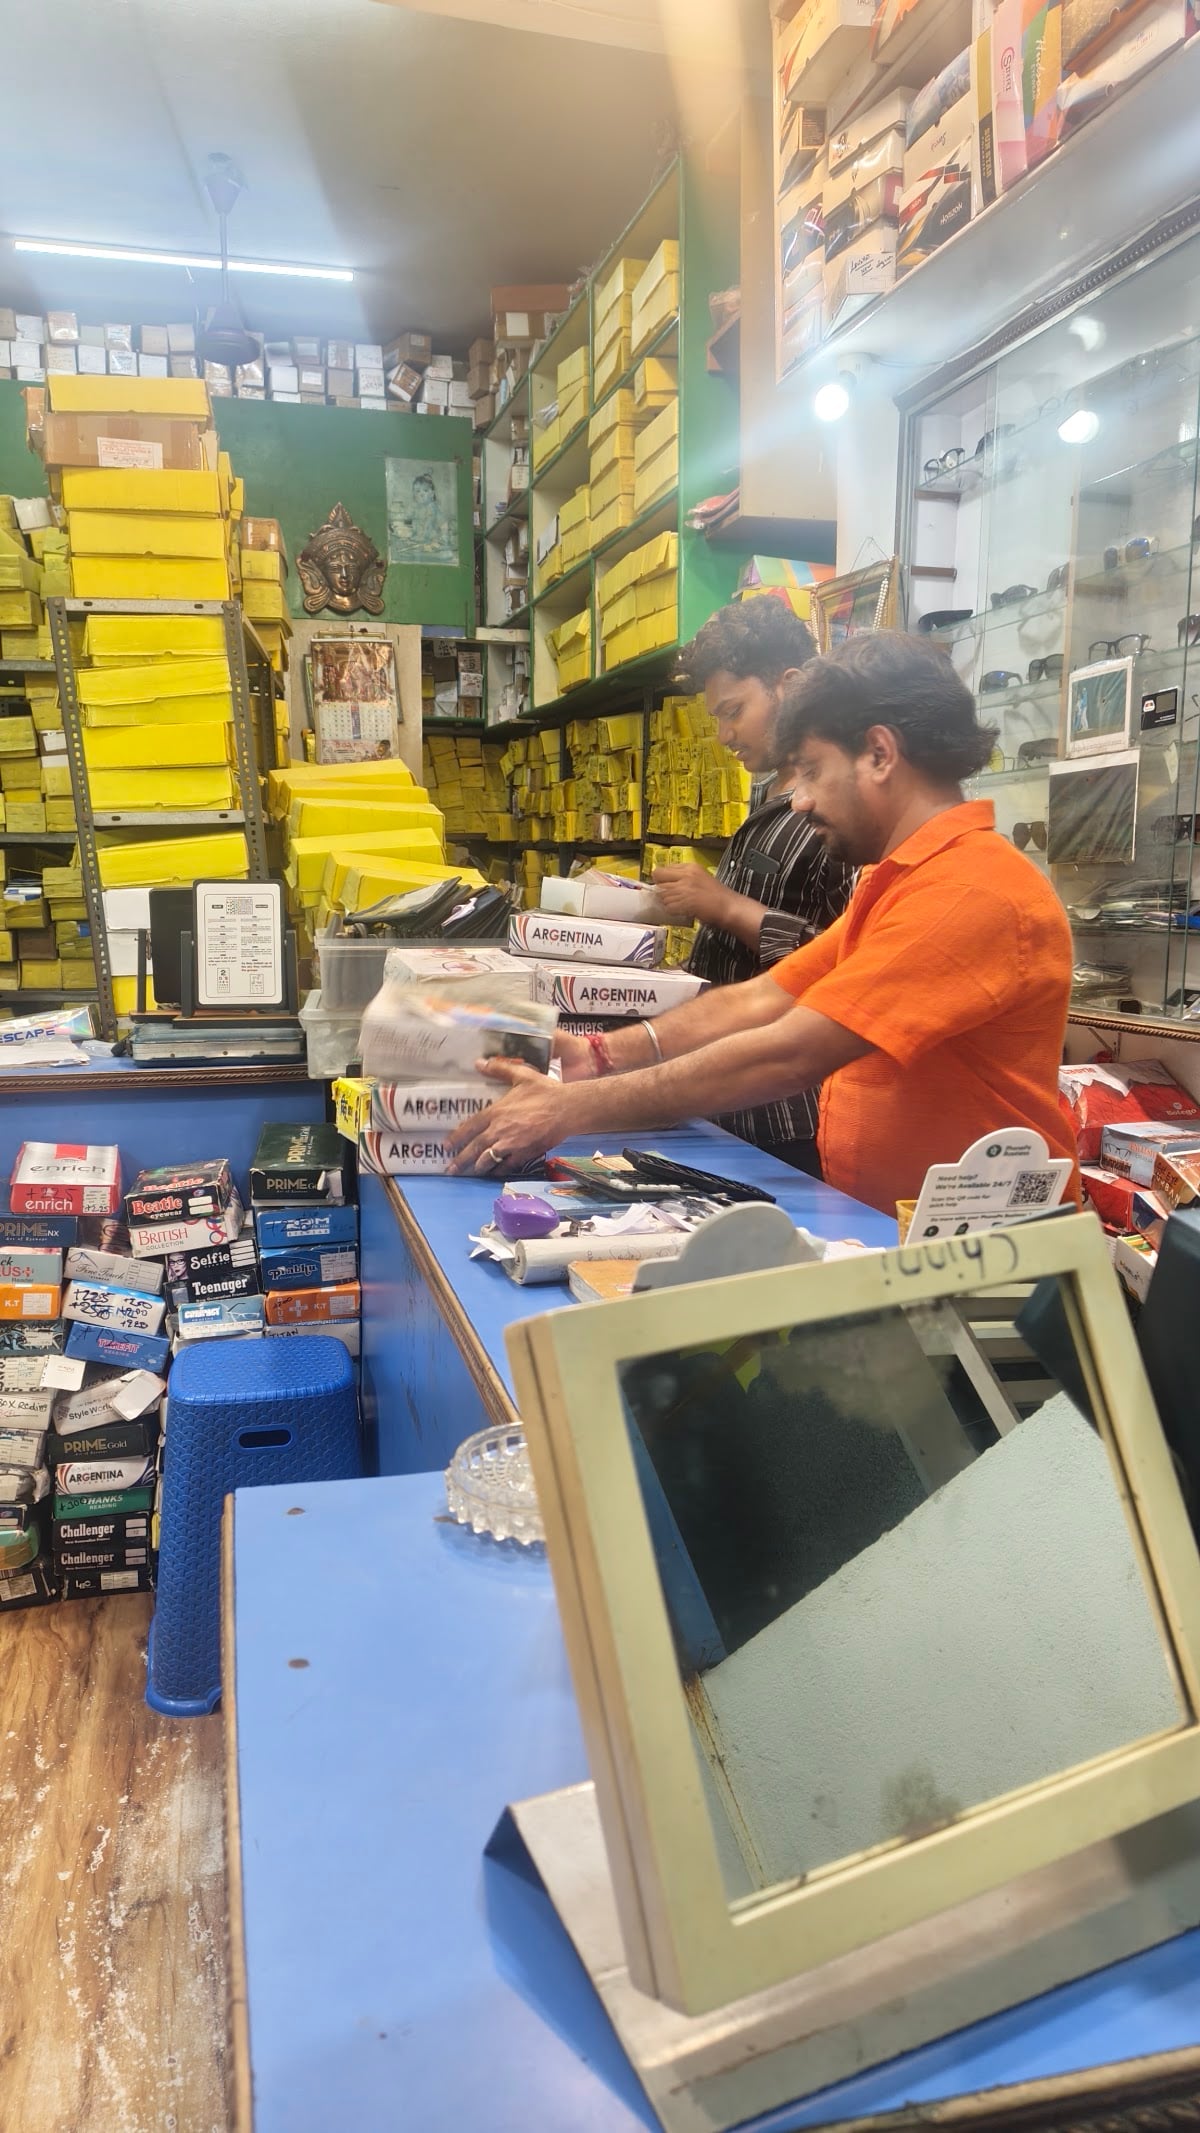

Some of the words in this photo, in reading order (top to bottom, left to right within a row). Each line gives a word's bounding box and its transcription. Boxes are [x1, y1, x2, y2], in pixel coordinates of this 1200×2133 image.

[532, 927, 604, 946] ARGENTINA
[580, 987, 658, 1004] ARGENTINA
[30, 1165, 106, 1173] enrich
[266, 1179, 308, 1190] PRIME
[25, 1199, 73, 1210] enrich
[131, 1196, 183, 1215] Beatle
[149, 1210, 183, 1219] eyewear
[138, 1227, 189, 1246] BRITISH
[146, 1241, 185, 1250] COLLECTION
[190, 1252, 230, 1270] Selfie
[192, 1278, 248, 1296] Teenager
[68, 1410, 89, 1421] Style
[63, 1438, 108, 1454] PRIME
[107, 1440, 128, 1450] Gold
[68, 1469, 124, 1484] ARGENTINA
[60, 1523, 116, 1539] Challenger
[60, 1551, 115, 1566] Challenger
